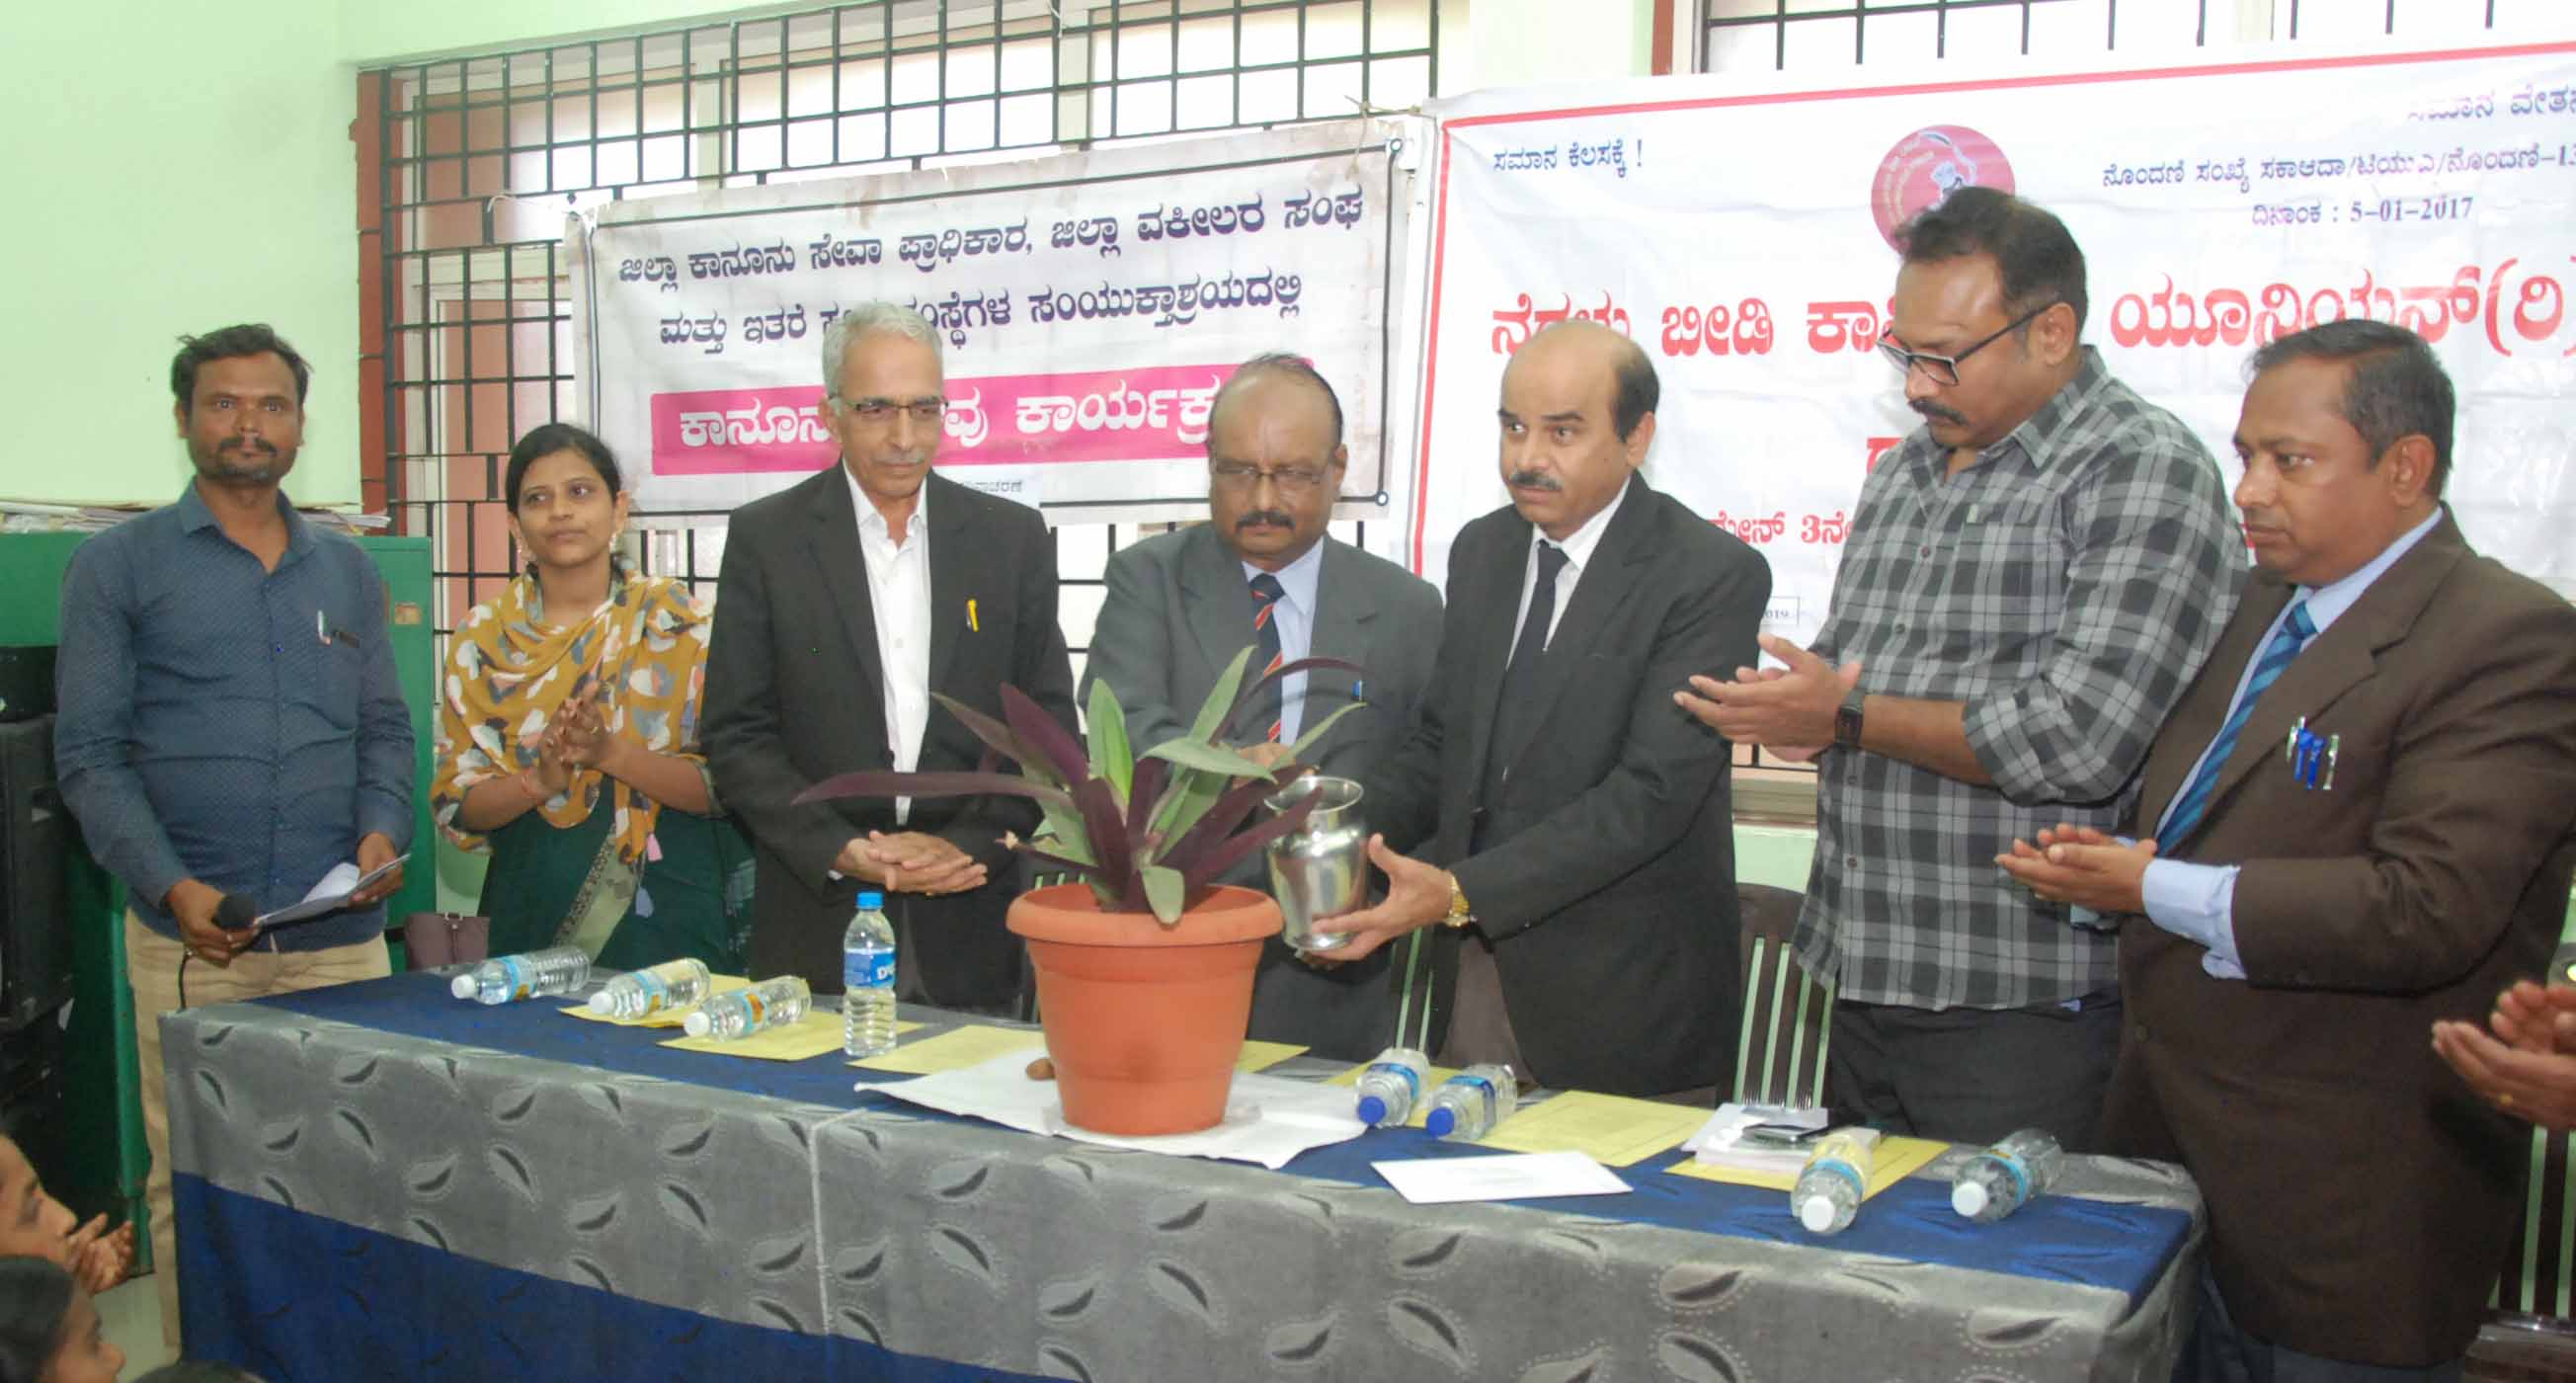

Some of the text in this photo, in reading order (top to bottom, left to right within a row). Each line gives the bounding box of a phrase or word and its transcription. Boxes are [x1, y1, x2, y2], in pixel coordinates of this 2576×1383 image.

[1493, 144, 1558, 171] ಸಮಾನ
[1569, 138, 1628, 178] ಕೆಲಸಕ್ಕೆ
[2196, 156, 2251, 194] ಸಂಖ್ಯೆ
[618, 182, 1364, 293] ಜಿಲ್ಲಾ ಕಾನೂನು ಸೇವಾ ಪ್ರಾಧಿಕಾರ, ಜಿಲ್ಲಾ ವಕೀಲರ ಸಂಘ
[2252, 199, 2322, 225] ದಿನಾಂಕ
[2350, 197, 2474, 222] 5-01-2017
[660, 310, 728, 355] ಮತ್ತು
[743, 303, 808, 343] ಇತರೆ
[904, 289, 1011, 350] ಂಸ್ಥೆಗಳ
[1028, 266, 1303, 328] ಸಂಯುಕ್ತಾಶ್ರಯದಲ್ಲಿ
[1660, 297, 1775, 357] ಬೀಡಿ
[1015, 373, 1221, 445] ಕಾರ್ಯಕ್ರ
